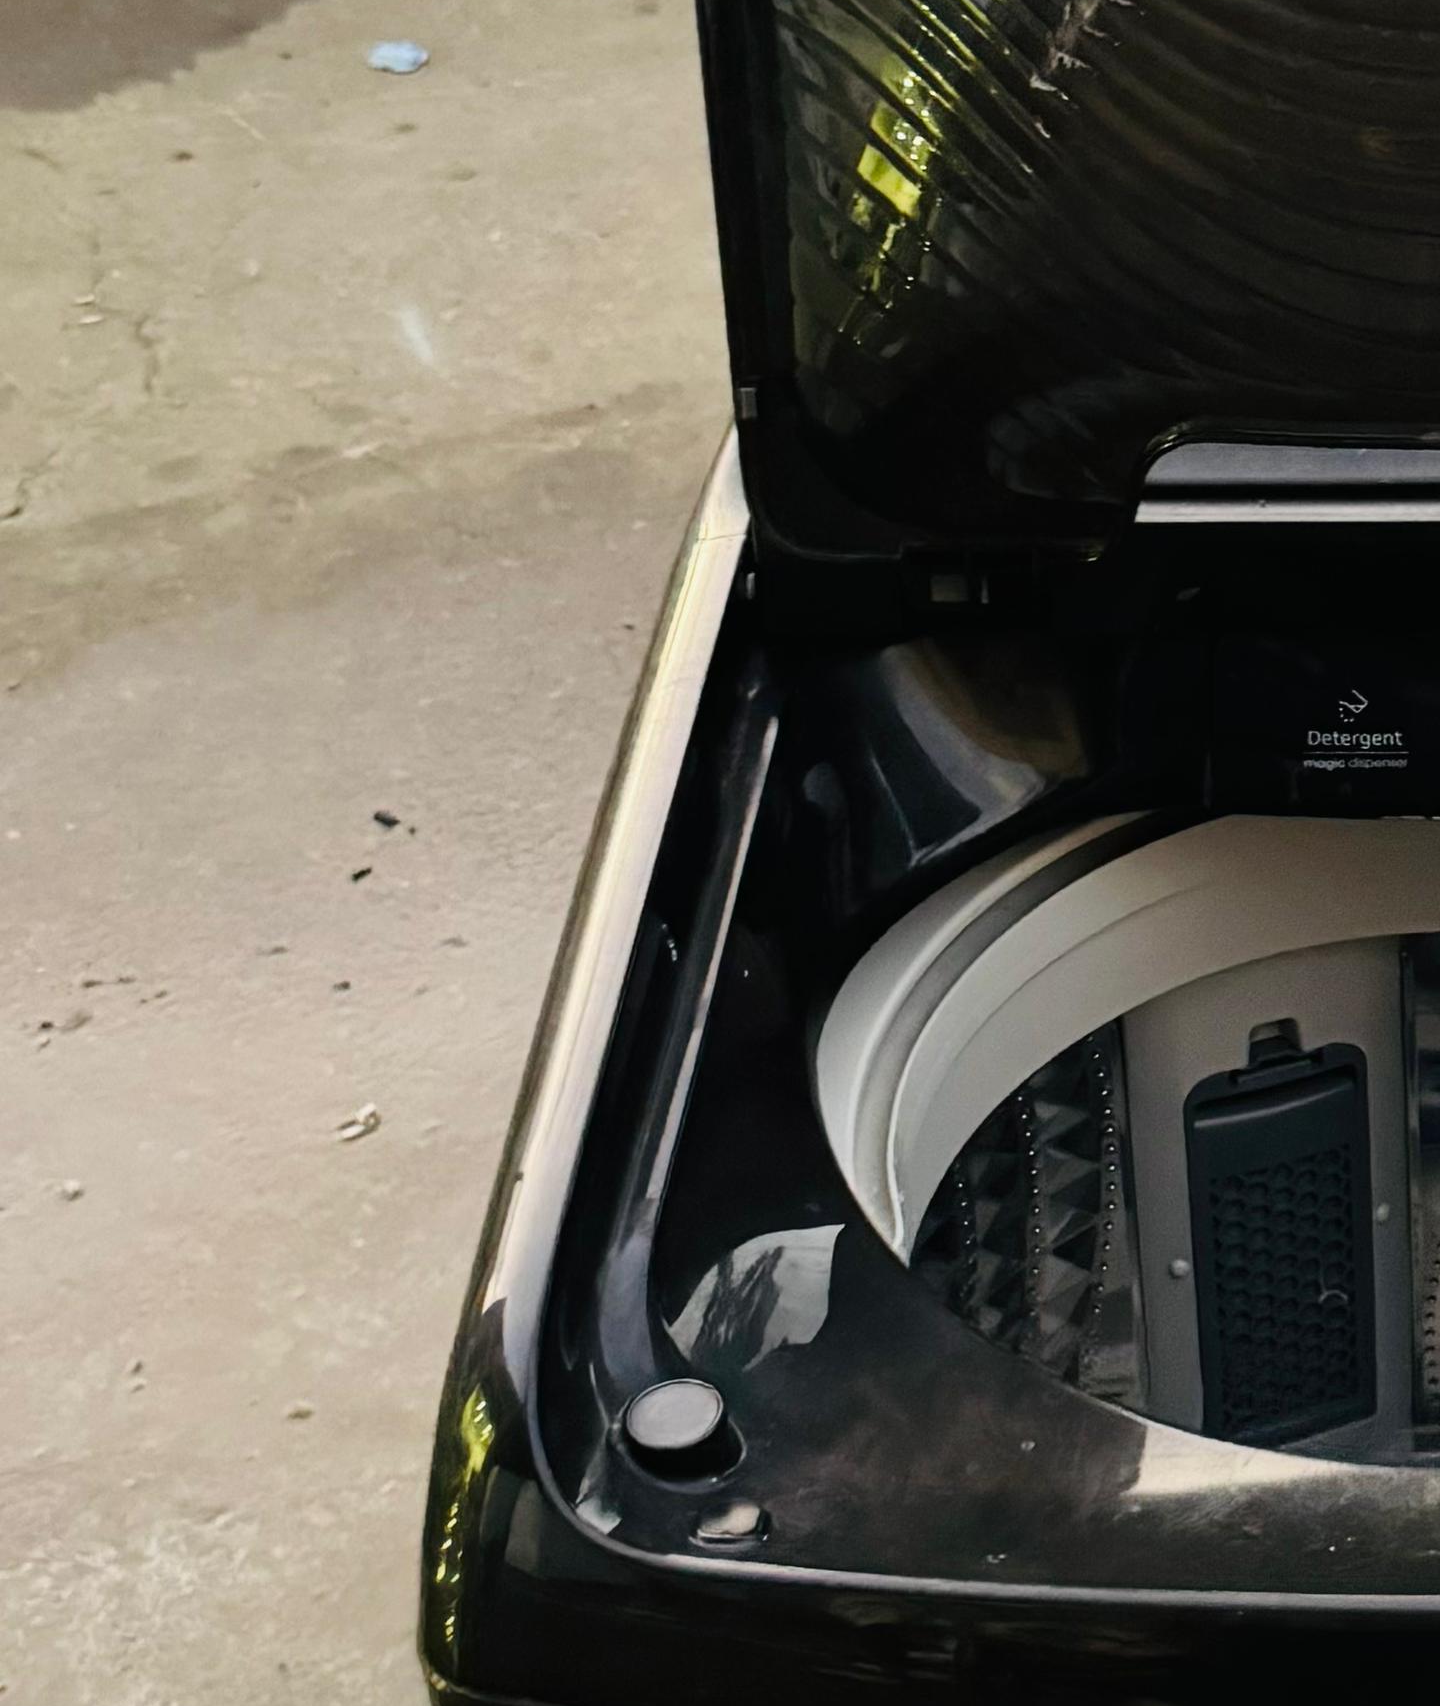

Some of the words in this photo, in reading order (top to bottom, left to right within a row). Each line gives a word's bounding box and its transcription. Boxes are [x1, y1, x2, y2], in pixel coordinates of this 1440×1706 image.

[1307, 730, 1403, 749] Detergent
[1303, 758, 1346, 771] magic
[1348, 757, 1408, 769] dispenser
